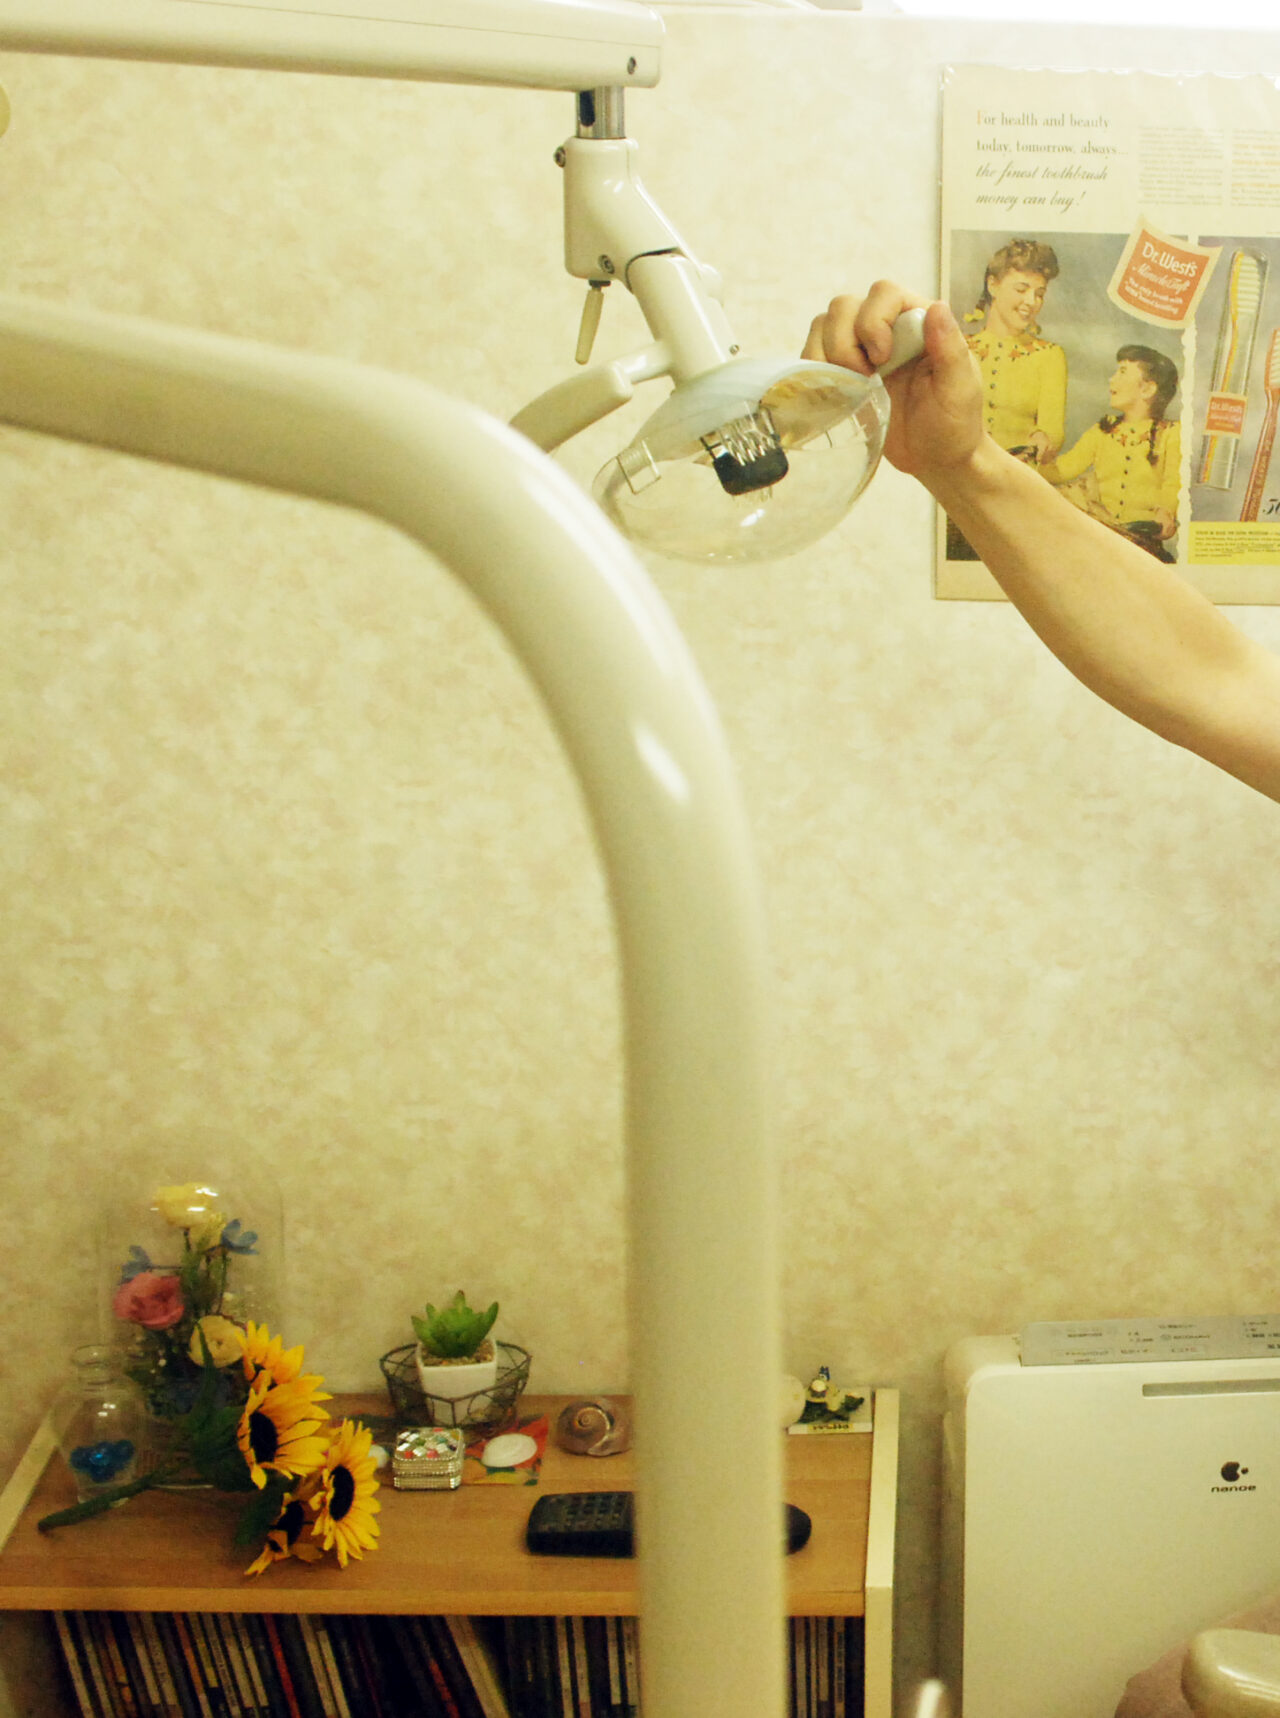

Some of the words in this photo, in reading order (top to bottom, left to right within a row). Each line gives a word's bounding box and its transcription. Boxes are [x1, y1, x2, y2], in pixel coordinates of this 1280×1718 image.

[976, 109, 996, 126] For
[1001, 111, 1038, 126] health
[1042, 113, 1065, 127] and
[1070, 112, 1110, 131] beauty
[976, 162, 998, 178] the
[994, 160, 1039, 186] finest
[1041, 165, 1109, 181] toothbrush
[976, 192, 1019, 212] money
[1022, 194, 1047, 205] can
[1049, 190, 1087, 215] buy!
[1210, 1485, 1257, 1493] nanoe
